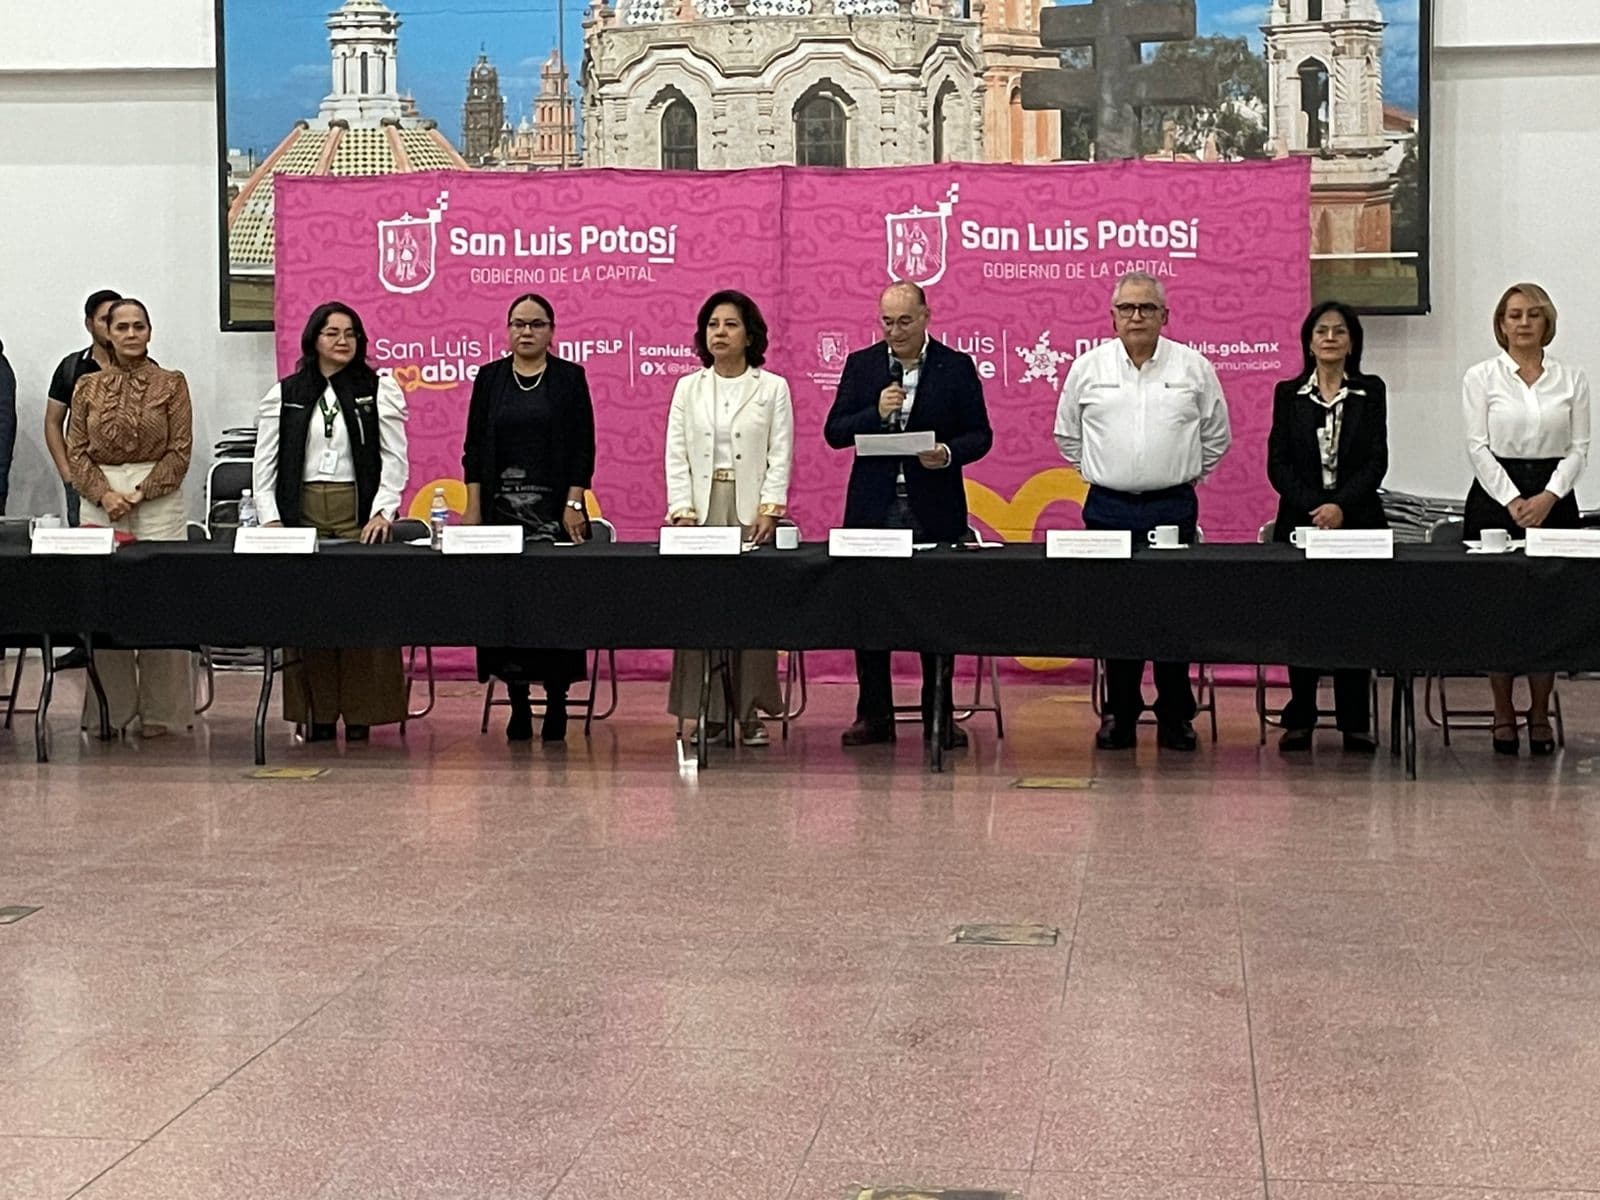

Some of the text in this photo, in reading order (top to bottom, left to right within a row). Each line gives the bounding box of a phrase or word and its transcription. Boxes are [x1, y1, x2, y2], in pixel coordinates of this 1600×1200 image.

[449, 224, 678, 257] San Luis PotoSí
[960, 218, 1199, 252] San Luis PotoSí
[470, 265, 656, 285] GOBIERNO DE LA CAPITAL
[983, 260, 1178, 280] GOBIERNO DE LA CAPITAL
[375, 335, 482, 360] San Luis
[559, 339, 623, 362] DIF SLP
